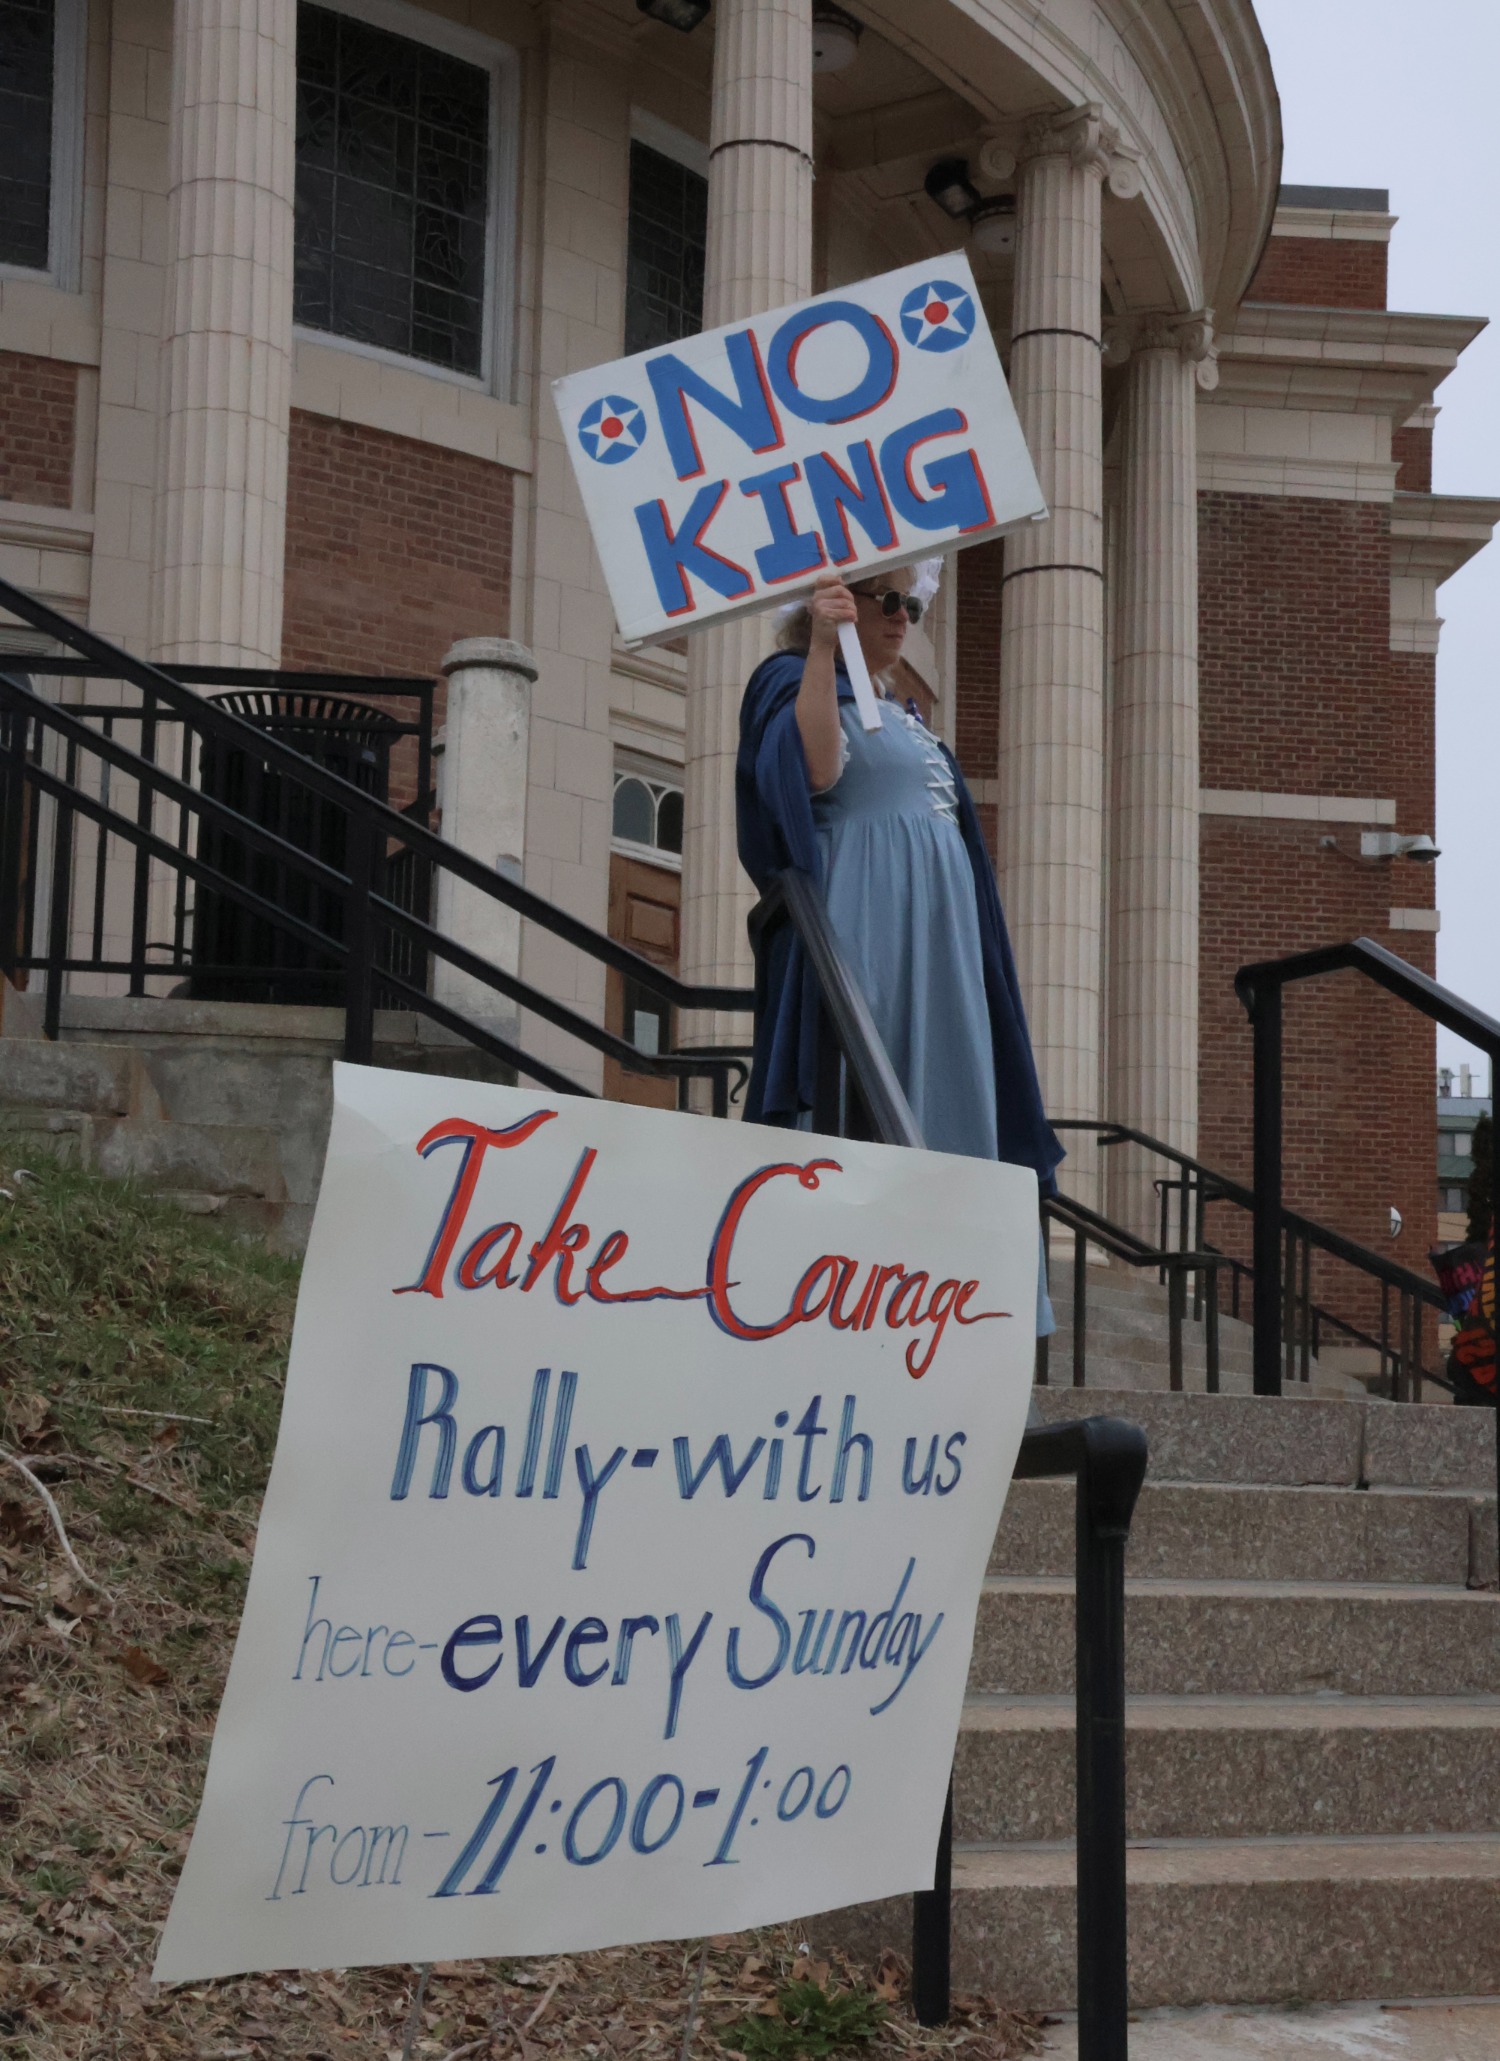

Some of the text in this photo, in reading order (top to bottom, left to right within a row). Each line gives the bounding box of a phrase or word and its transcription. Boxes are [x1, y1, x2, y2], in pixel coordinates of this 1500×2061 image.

[645, 300, 900, 482] NO
[634, 408, 996, 617] KING
[392, 1109, 1013, 1380] Take Courage
[901, 1431, 968, 1498] us
[726, 1533, 944, 1716] Sunday
